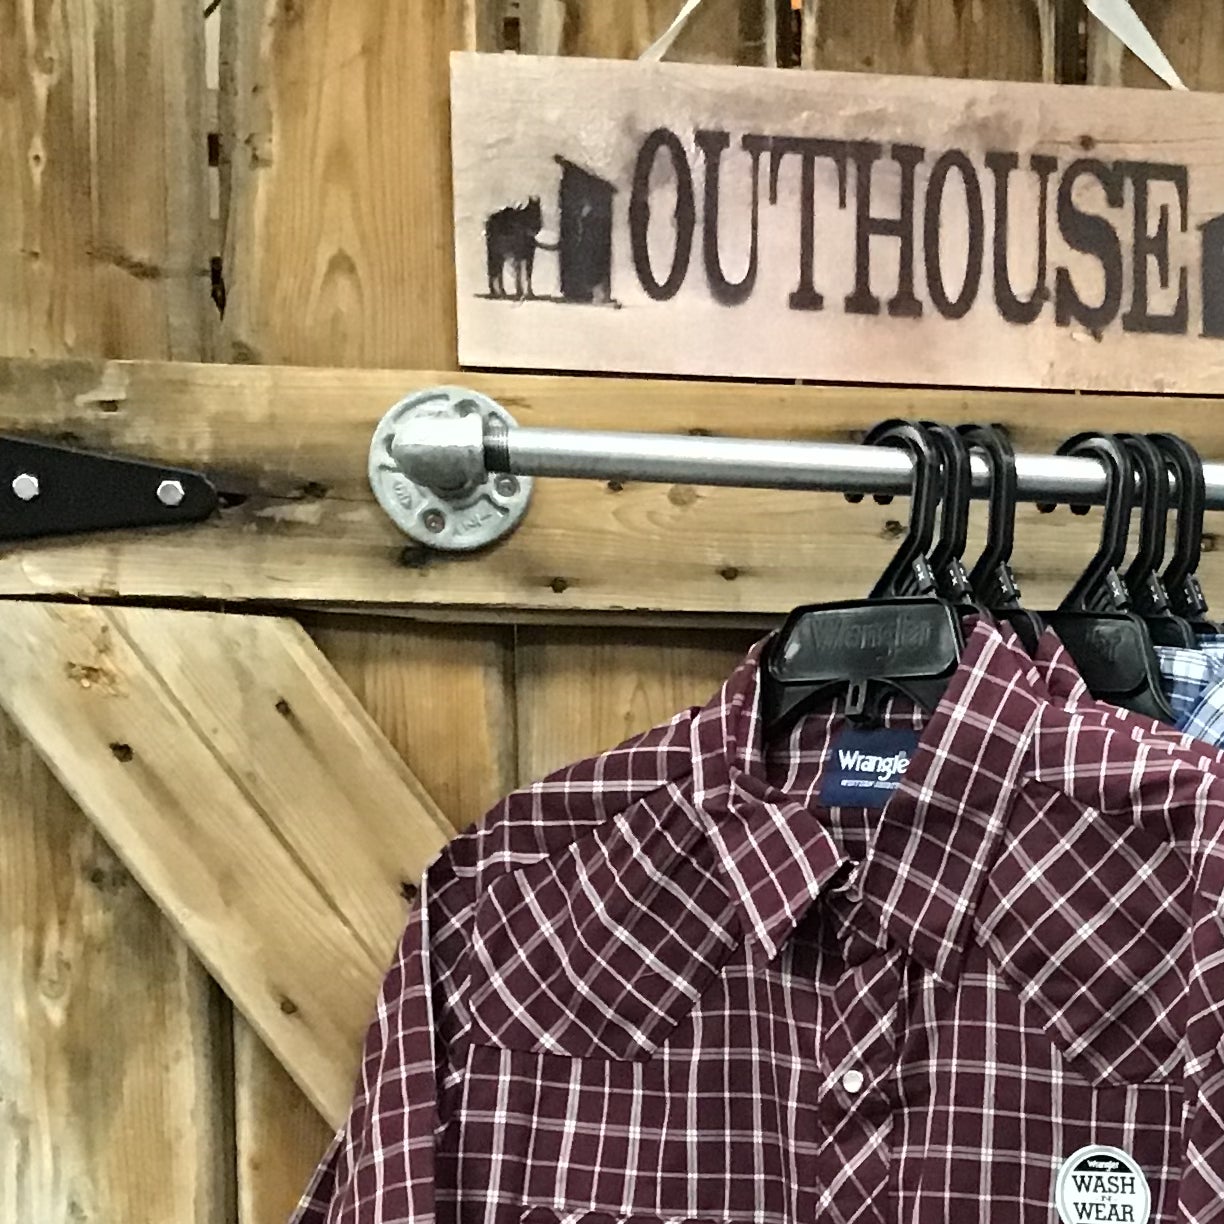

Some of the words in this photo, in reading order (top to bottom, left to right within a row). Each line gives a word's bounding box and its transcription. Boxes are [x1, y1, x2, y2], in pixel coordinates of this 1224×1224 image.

[629, 127, 1189, 336] OUTHOUSE
[838, 749, 911, 781] Wrangle
[1072, 1175, 1136, 1194] WASH
[1073, 1202, 1135, 1222] WEAR
